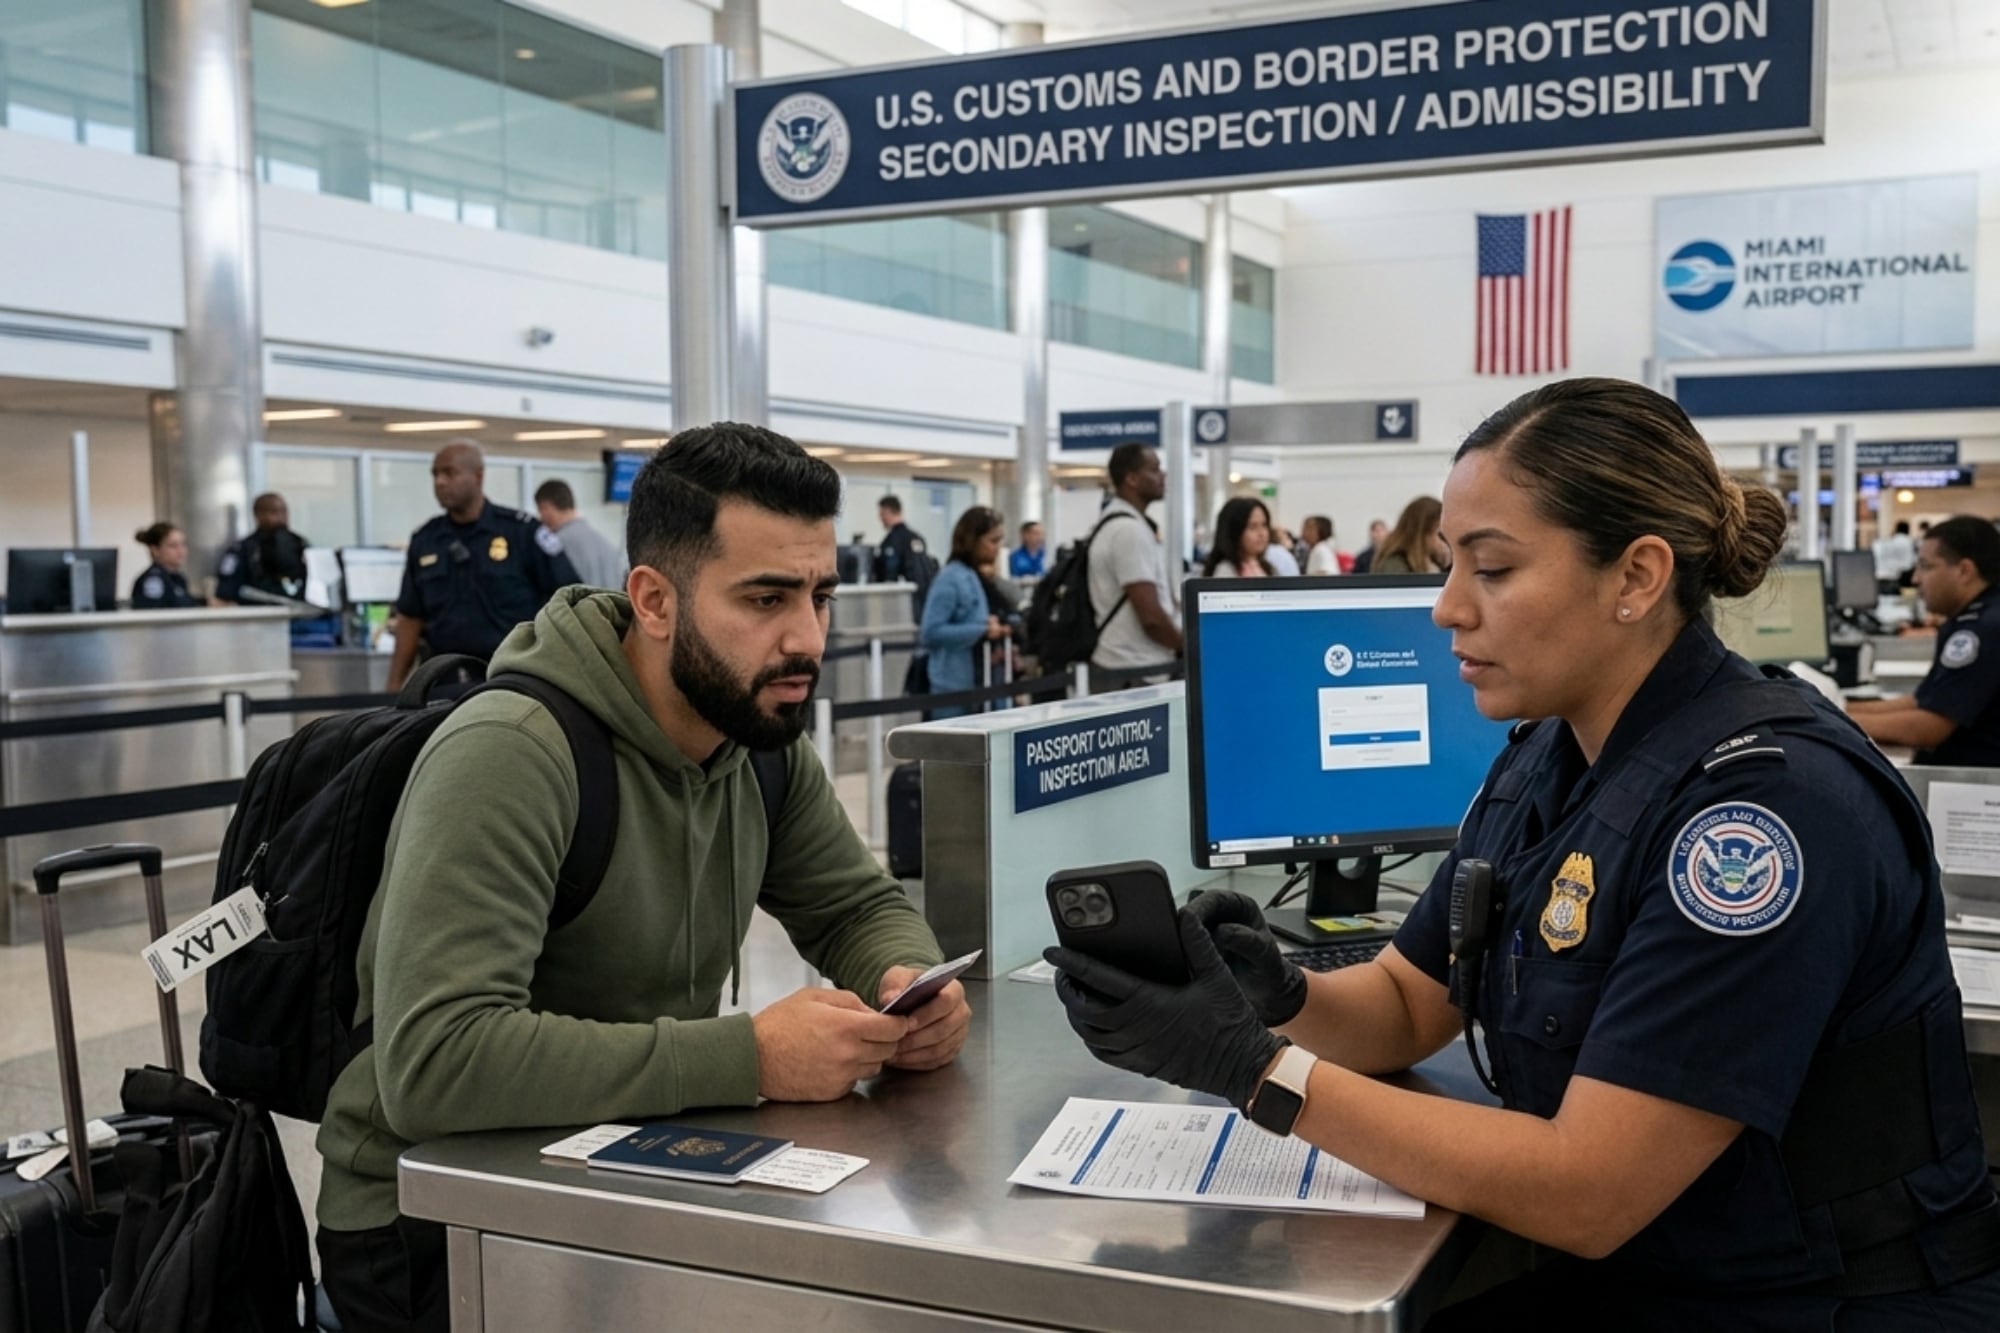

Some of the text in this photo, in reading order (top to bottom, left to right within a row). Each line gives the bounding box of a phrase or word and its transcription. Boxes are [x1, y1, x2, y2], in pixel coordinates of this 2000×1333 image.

[875, 0, 1768, 130] U.S. CUSTOMS AND BORDER PROTECTION
[879, 124, 1114, 181] SECONDARY
[1123, 98, 1377, 159] INSPECTION
[1387, 94, 1406, 135] /
[1414, 59, 1771, 132] ADMISSIBILITY
[1744, 237, 1825, 258] MIAMI
[1744, 253, 1969, 283] INTERNATIONAL
[1744, 283, 1864, 308] AIRPORT
[1026, 729, 1097, 767] PASSPORT
[1039, 745, 1151, 794] INSPECTION AREA
[171, 916, 237, 970] LAX
